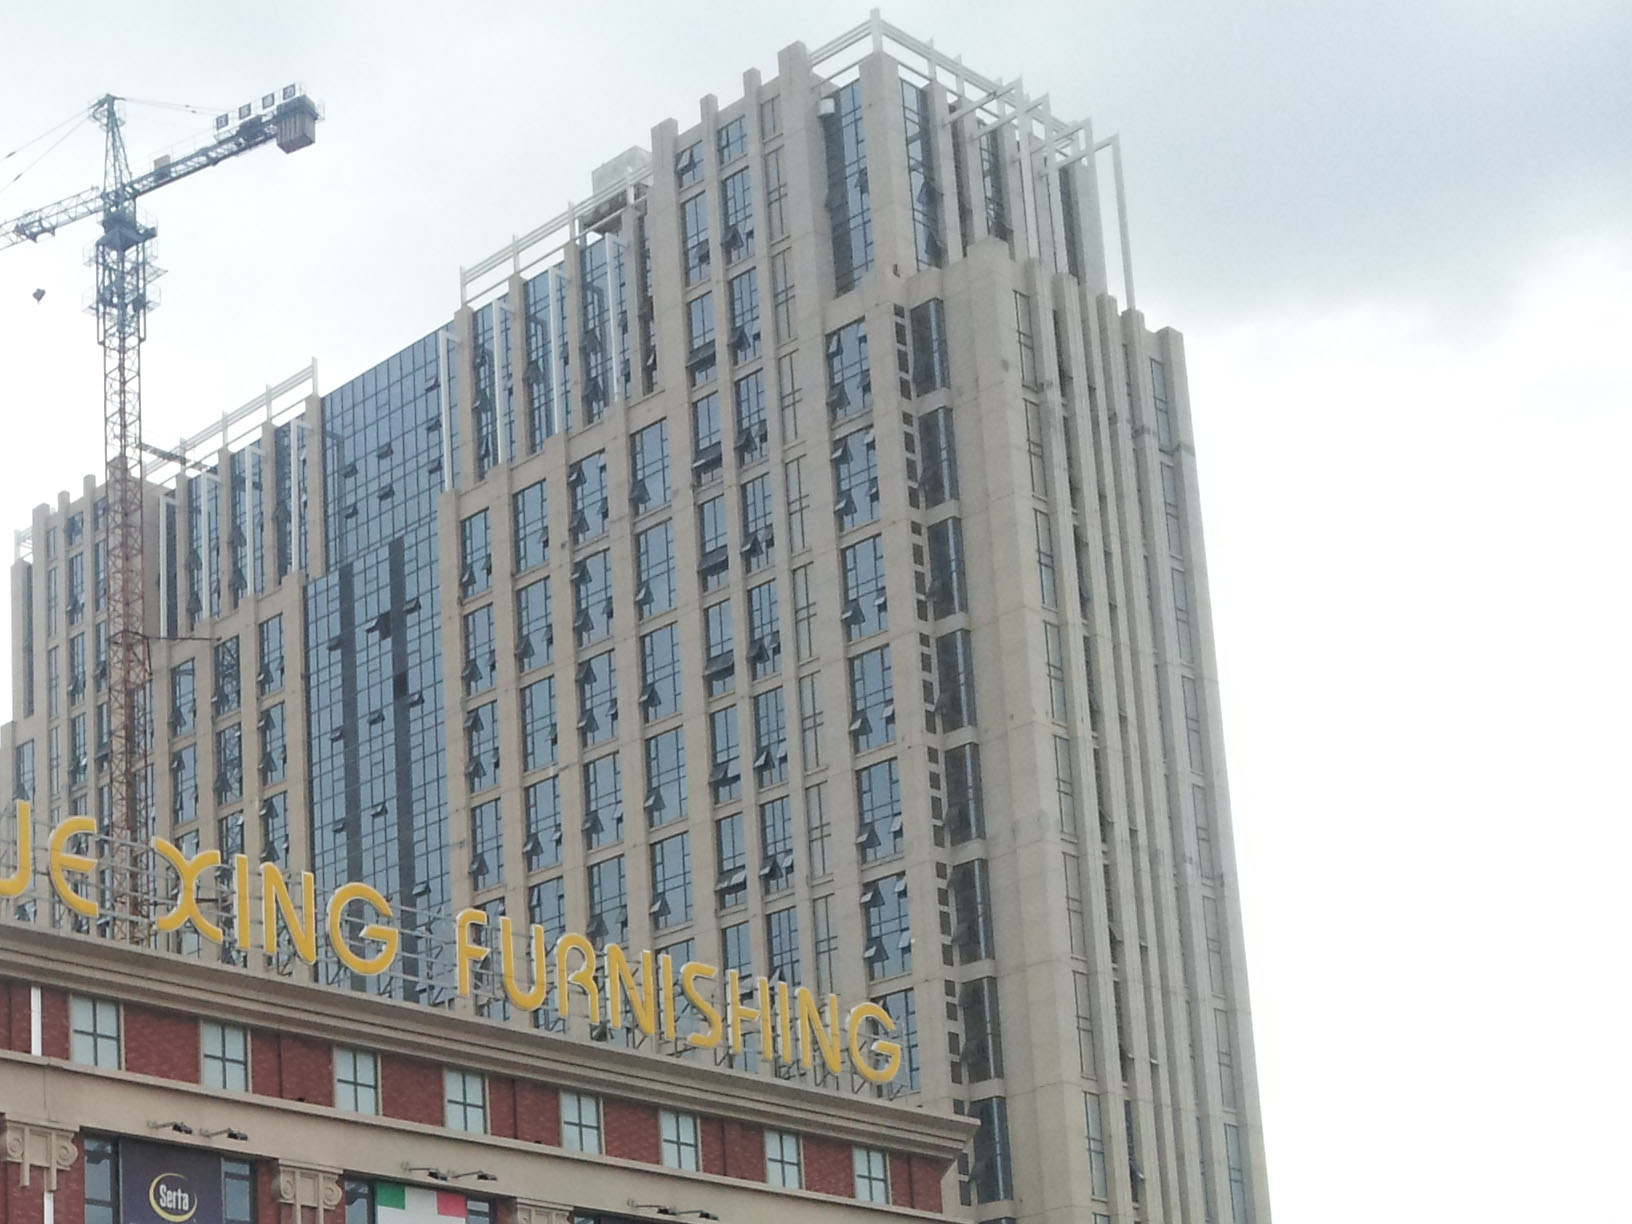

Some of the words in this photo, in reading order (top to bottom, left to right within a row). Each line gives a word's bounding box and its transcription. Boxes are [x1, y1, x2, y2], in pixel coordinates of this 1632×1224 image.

[152, 835, 399, 976] XING
[456, 908, 902, 1083] FURNISHING
[159, 1184, 189, 1211] Serta
